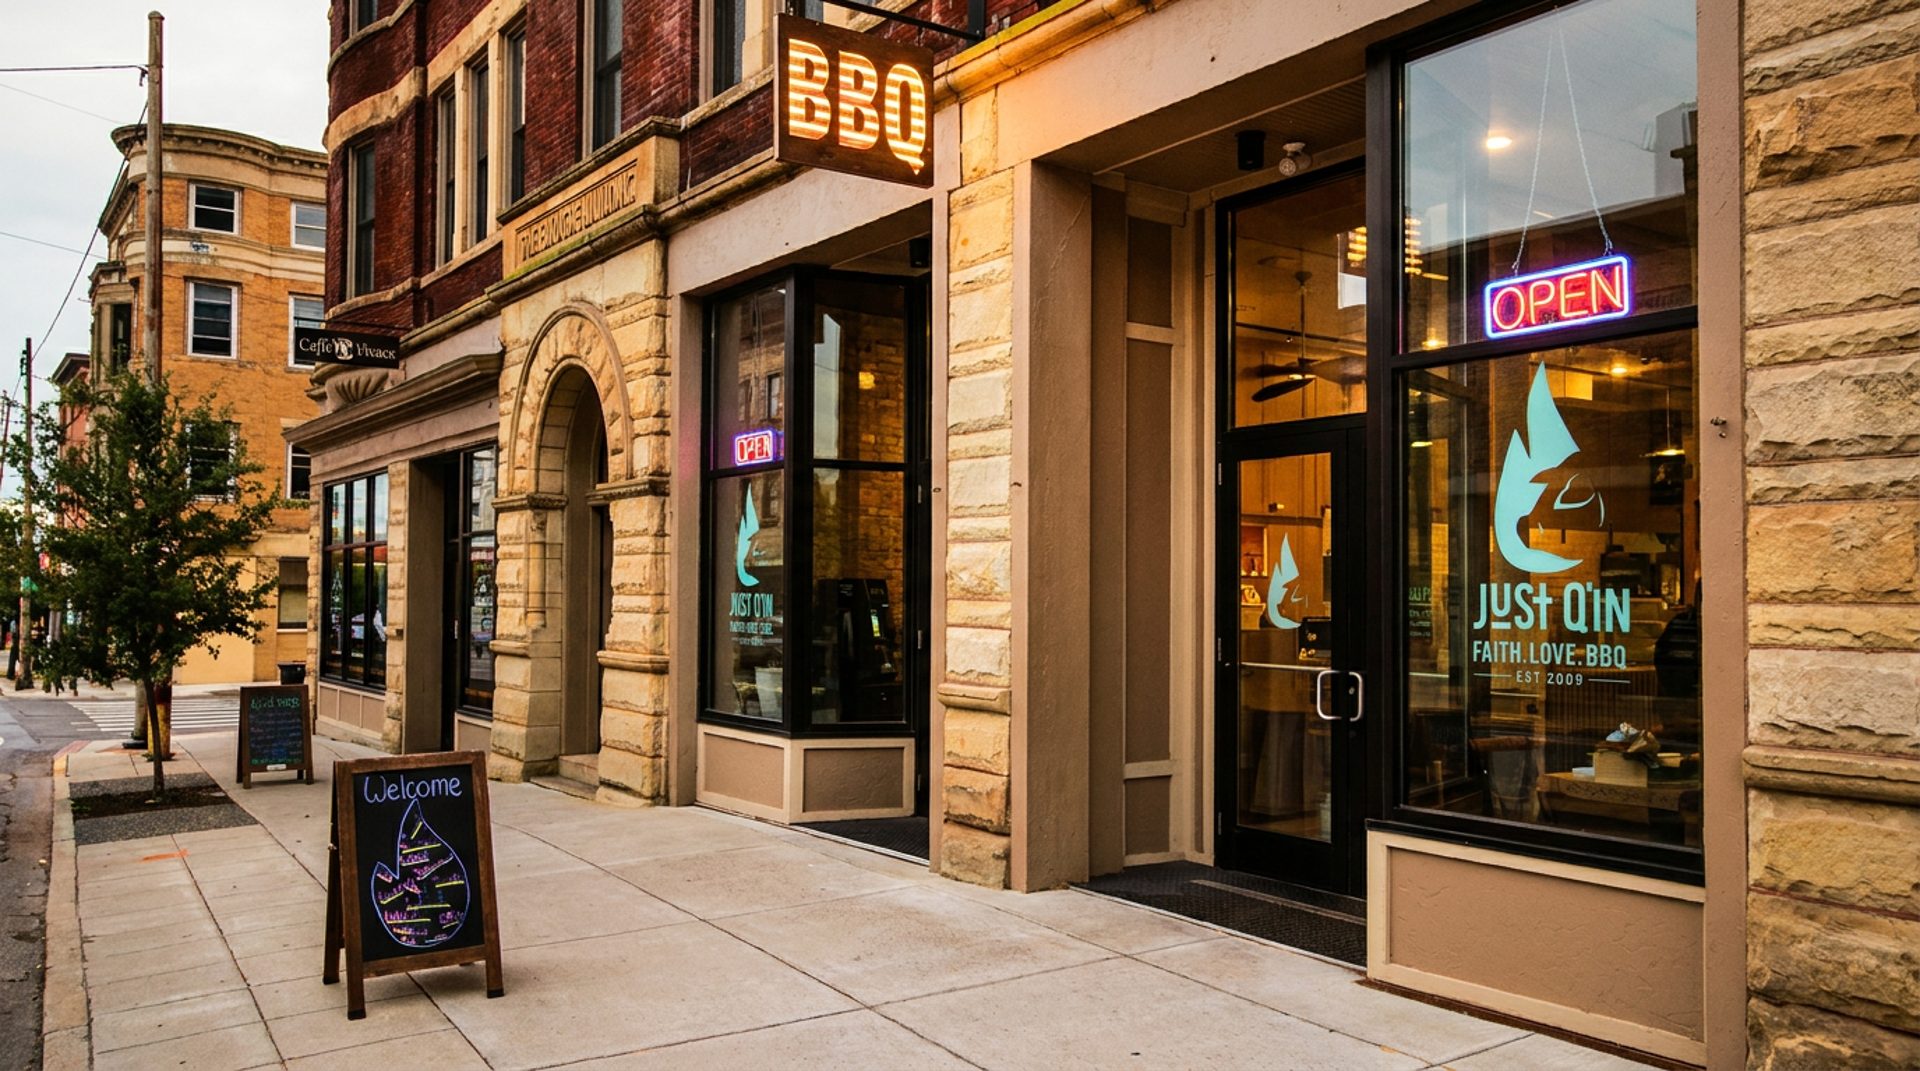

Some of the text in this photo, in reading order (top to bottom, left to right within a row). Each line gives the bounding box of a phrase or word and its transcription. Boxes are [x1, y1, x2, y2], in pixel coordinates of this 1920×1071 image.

[788, 38, 926, 176] BBQ
[1492, 264, 1623, 330] OPEN
[736, 436, 771, 463] OPEN
[1563, 581, 1631, 634] Q'IN
[1516, 670, 1584, 686] EST 2009
[363, 773, 463, 804] Welcome
